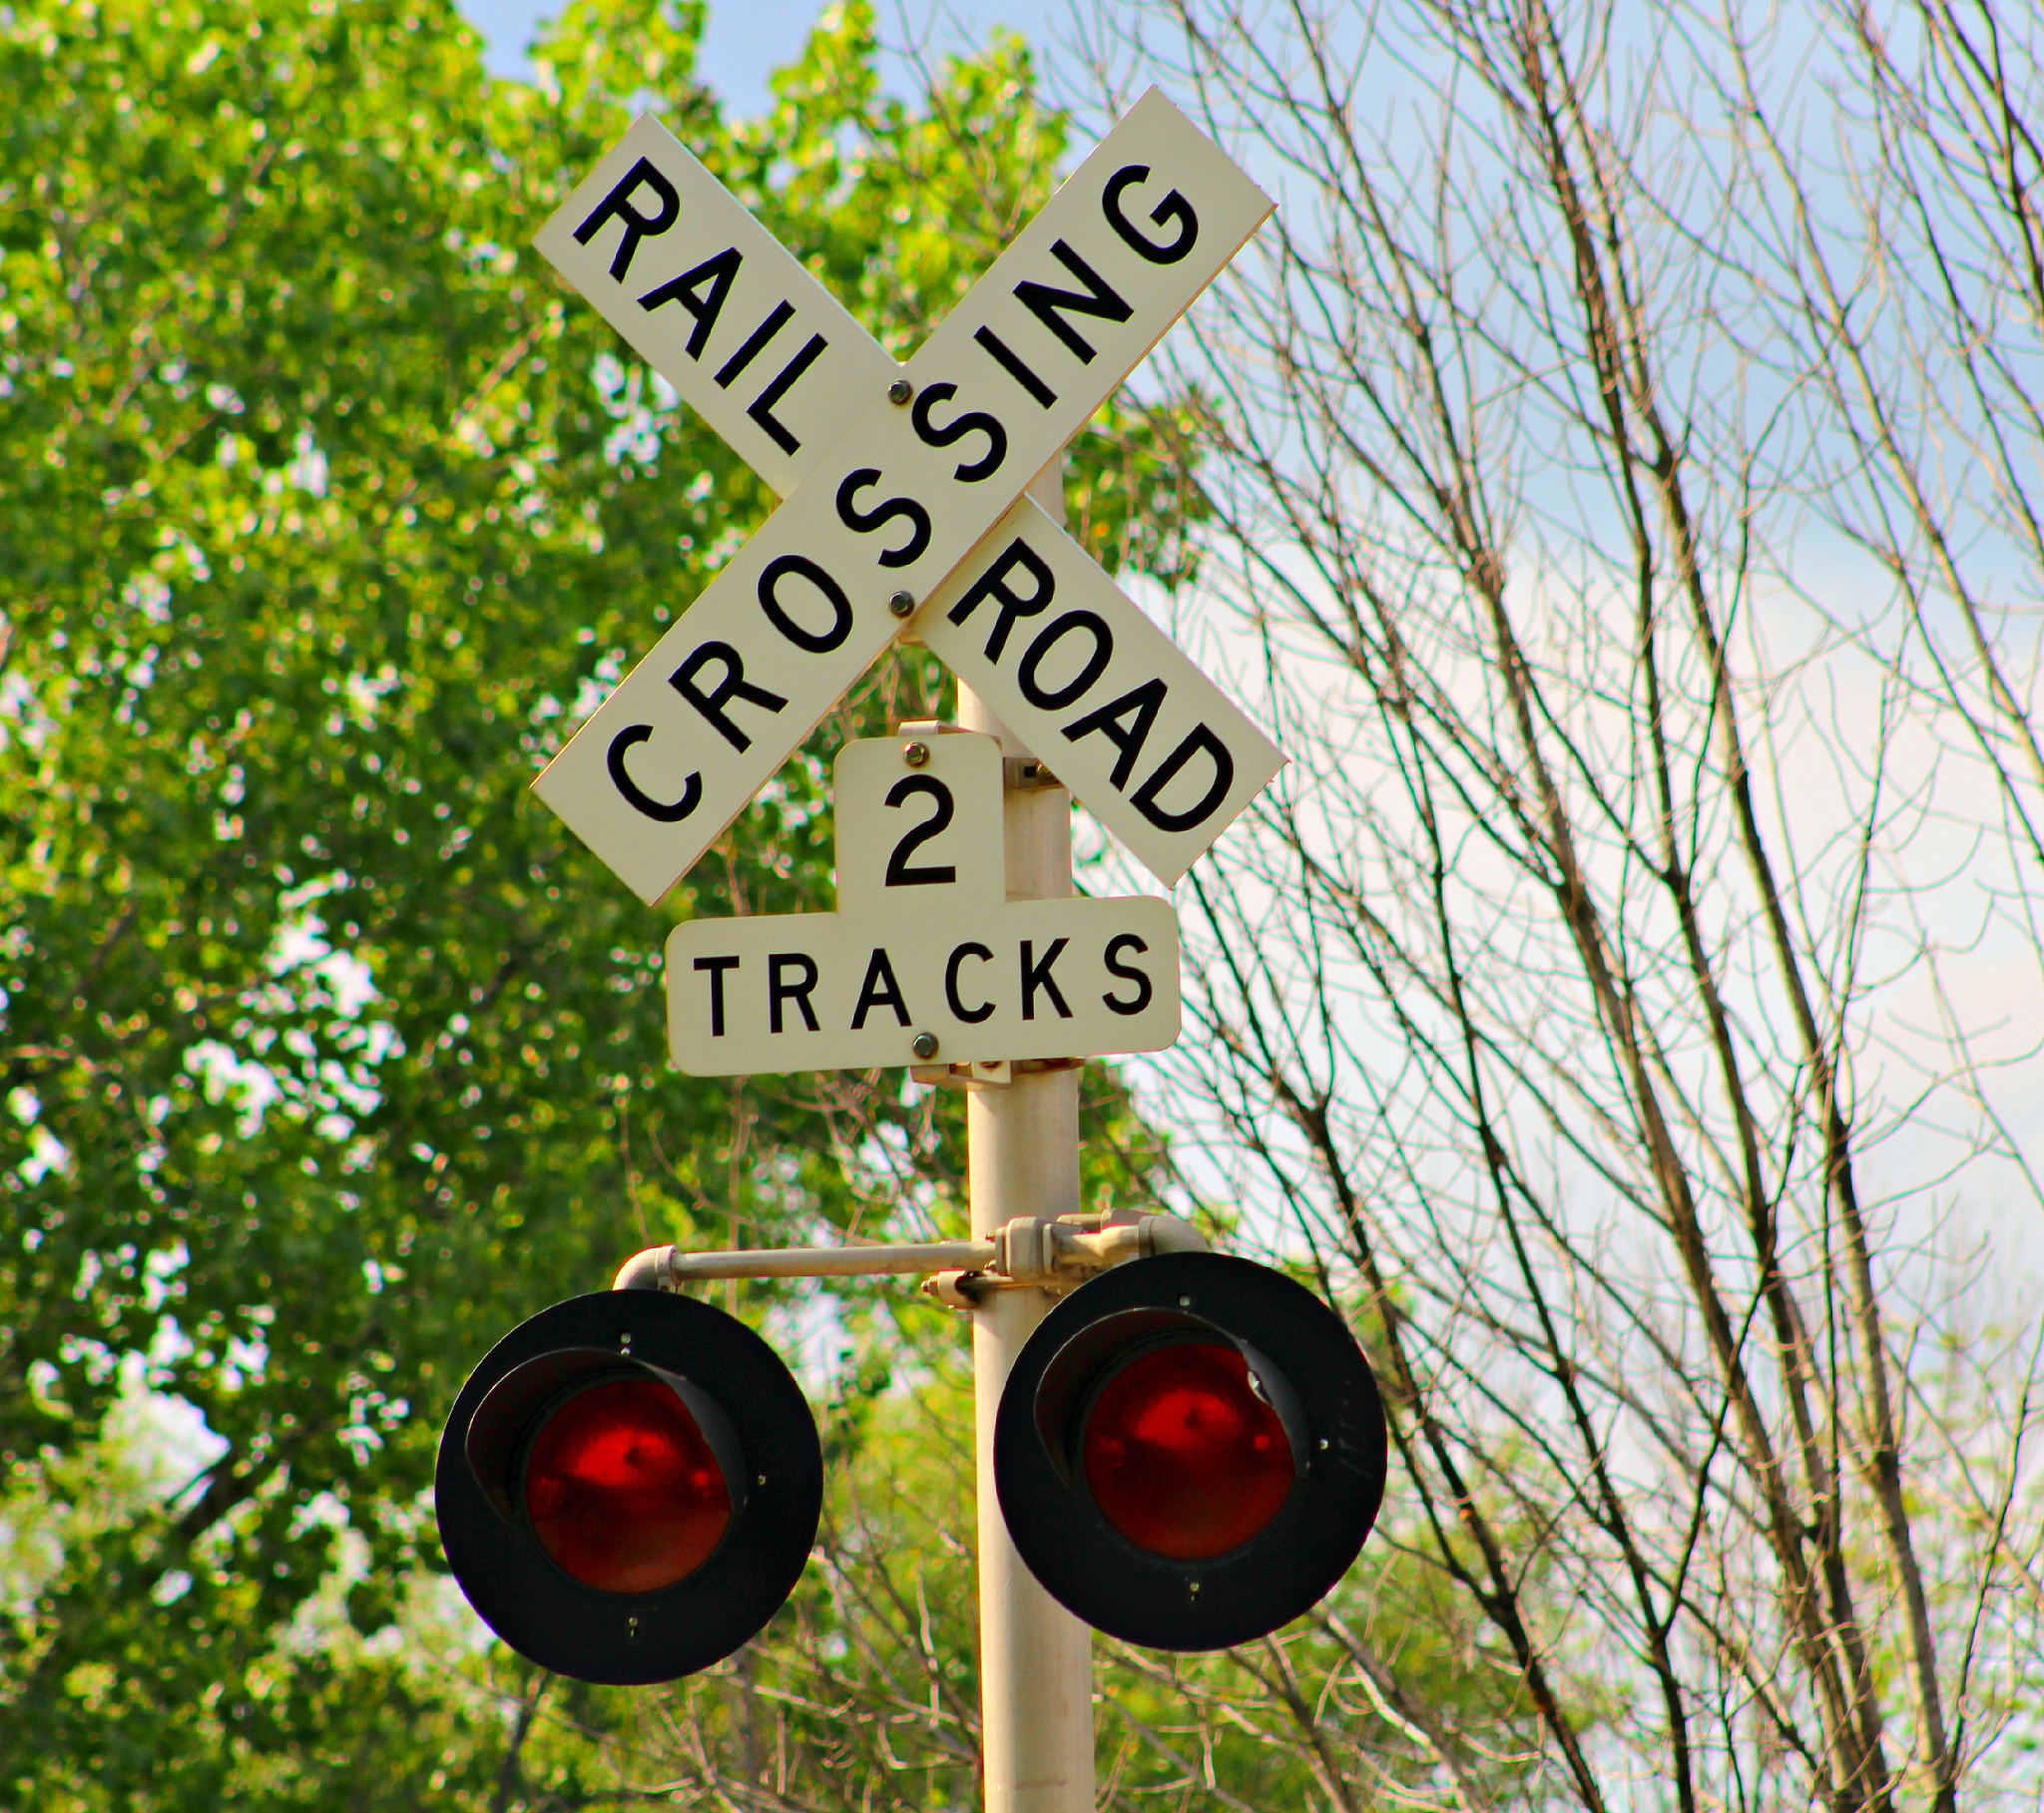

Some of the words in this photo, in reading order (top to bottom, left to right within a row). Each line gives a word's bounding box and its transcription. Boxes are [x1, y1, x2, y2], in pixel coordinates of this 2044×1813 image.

[572, 156, 828, 457] RAIL
[947, 536, 1234, 833] ROAD
[606, 165, 1199, 823] CROSSING
[693, 933, 1153, 1037] TRACKS
[884, 773, 956, 887] 2
